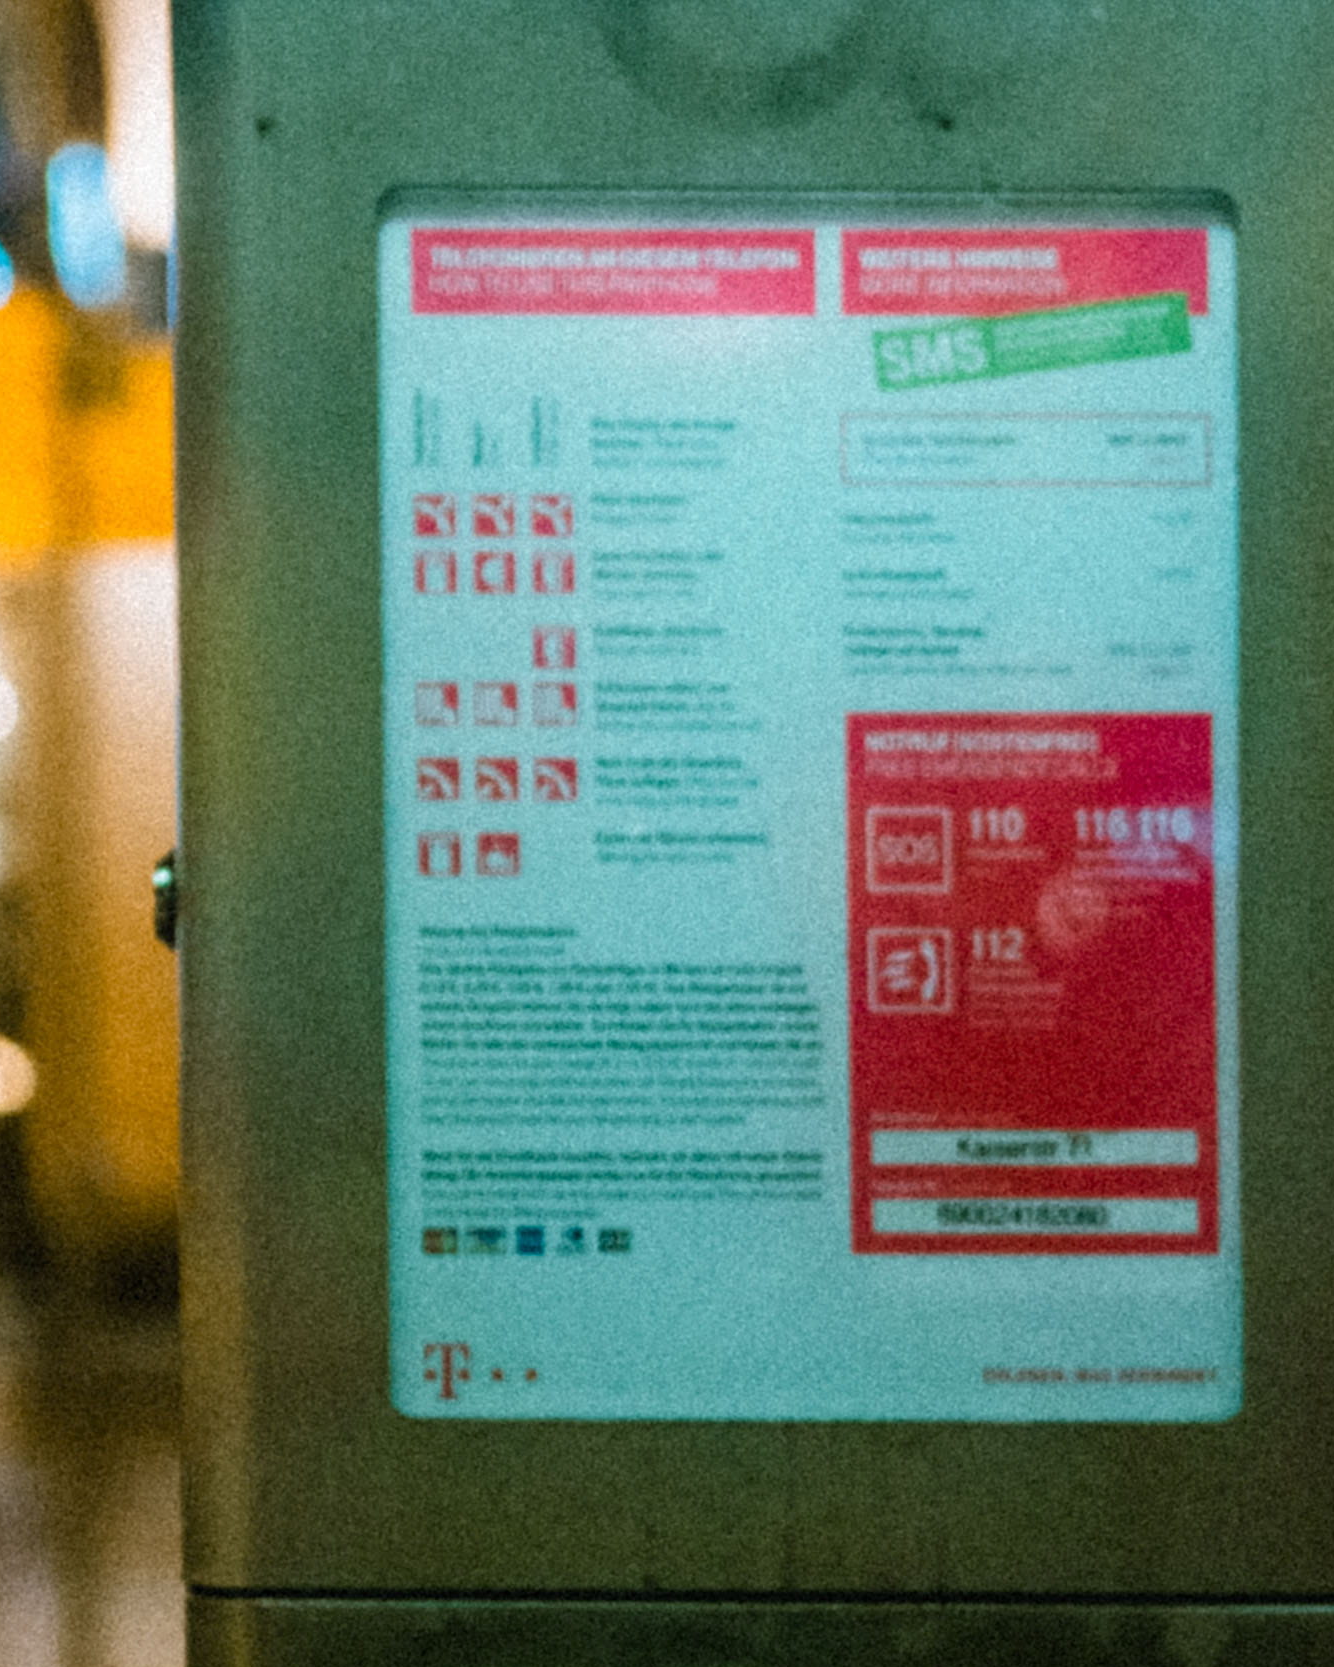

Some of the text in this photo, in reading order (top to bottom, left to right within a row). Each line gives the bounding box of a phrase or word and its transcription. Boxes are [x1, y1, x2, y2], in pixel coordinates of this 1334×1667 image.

[878, 325, 990, 382] SMS
[969, 807, 1027, 841] 110
[1074, 806, 1195, 843] 116 116
[970, 928, 1025, 961] 112
